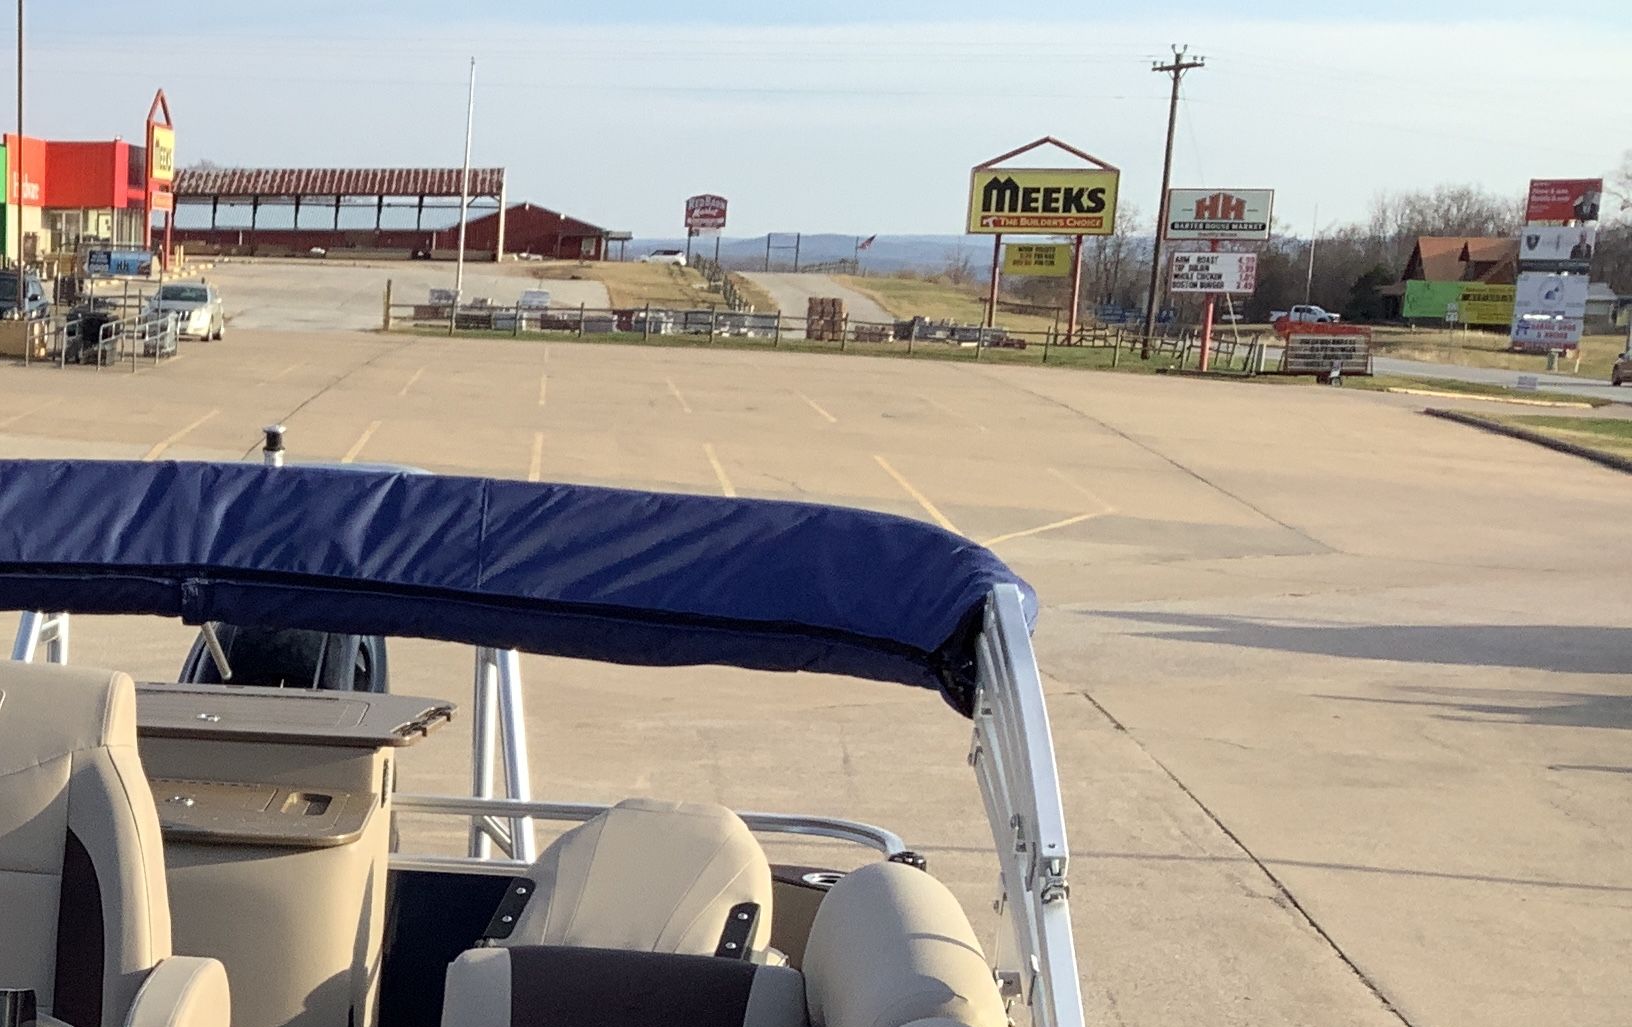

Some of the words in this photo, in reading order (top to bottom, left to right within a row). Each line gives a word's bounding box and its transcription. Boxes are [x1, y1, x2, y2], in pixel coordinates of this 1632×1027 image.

[1194, 192, 1247, 220] HH
[1000, 217, 1018, 226] THE
[1066, 218, 1101, 227] CHOICE
[1197, 256, 1219, 264] ROAST
